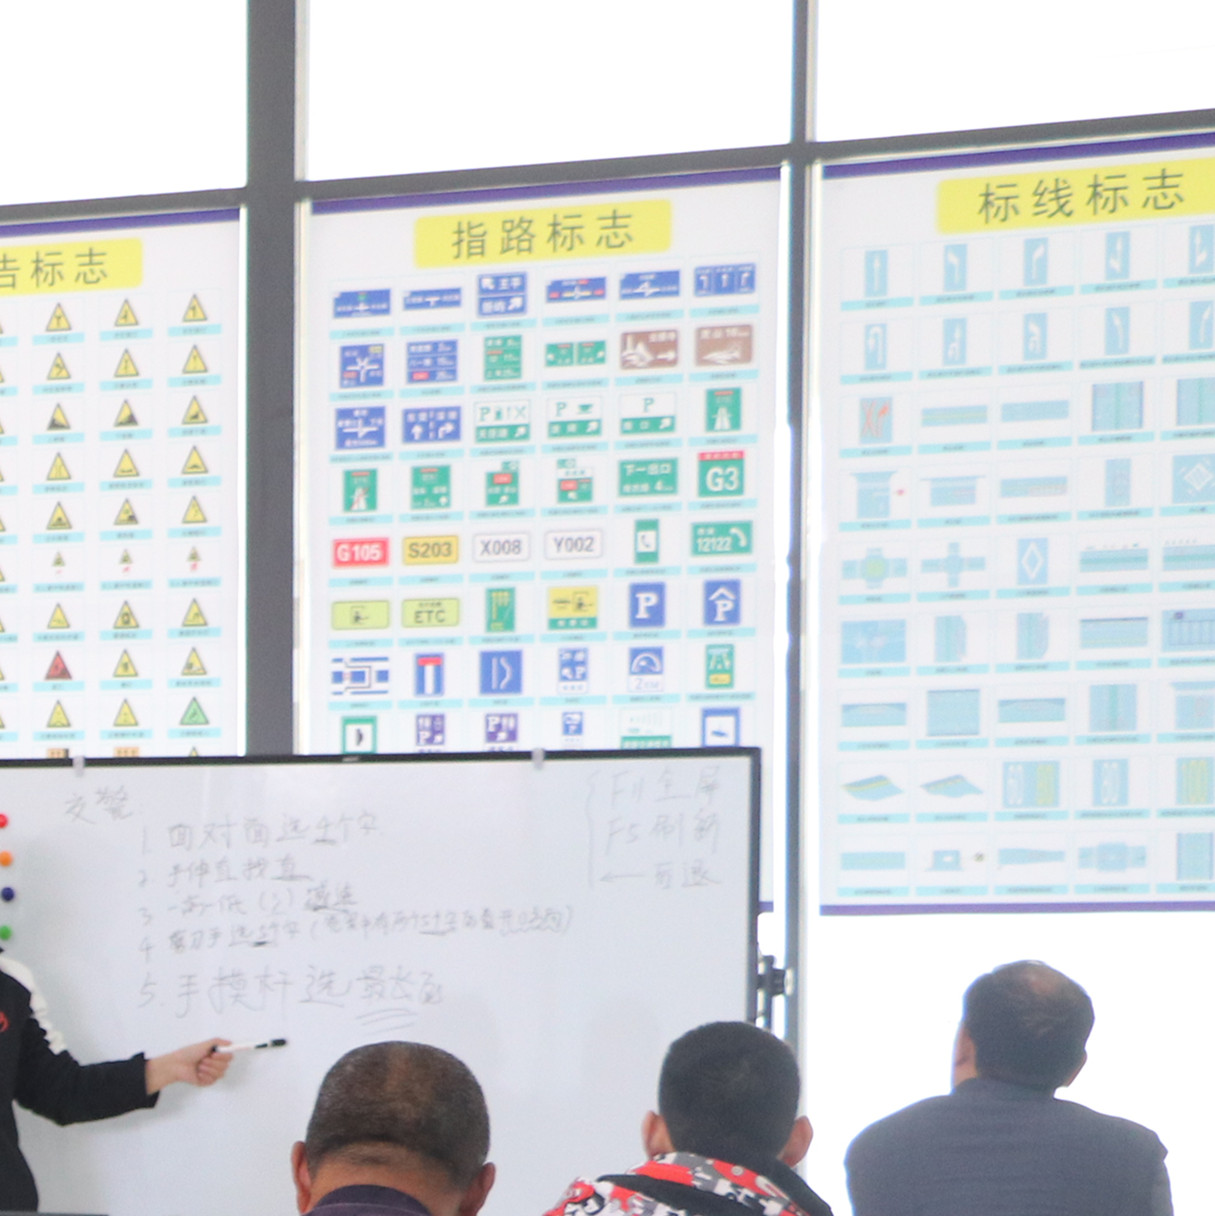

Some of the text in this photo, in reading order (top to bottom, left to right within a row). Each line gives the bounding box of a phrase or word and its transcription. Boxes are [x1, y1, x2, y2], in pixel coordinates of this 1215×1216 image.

[978, 167, 1186, 225] 标线标志
[452, 209, 634, 260] 指路标志
[706, 466, 739, 492] G3
[337, 543, 383, 562] G105
[408, 542, 452, 559] S203
[479, 539, 522, 556] X008
[553, 537, 595, 553] Y002
[636, 593, 658, 619] P
[715, 597, 734, 621] P
[413, 609, 446, 625] ETC
